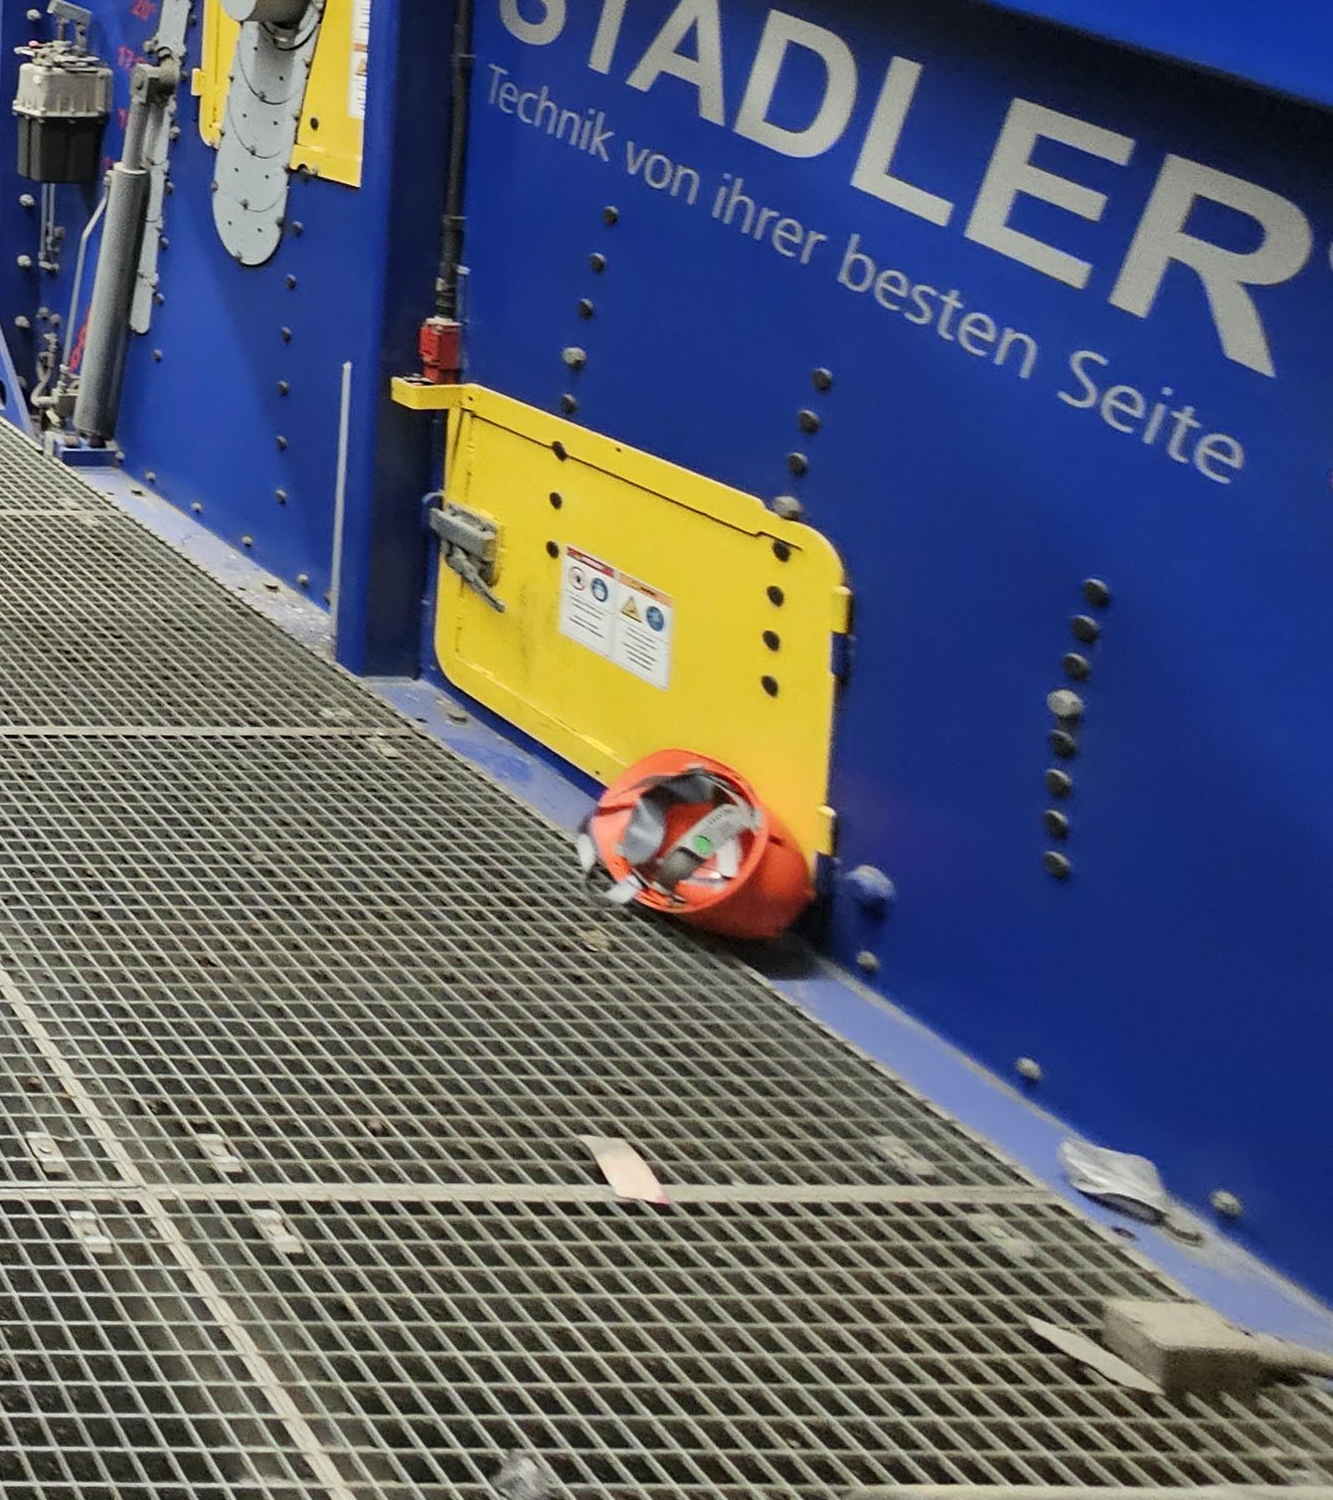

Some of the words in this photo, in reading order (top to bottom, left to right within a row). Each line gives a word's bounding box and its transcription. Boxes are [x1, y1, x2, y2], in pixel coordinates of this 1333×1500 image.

[487, 64, 615, 162] Technik
[626, 140, 700, 205] von
[711, 172, 828, 266] ihrer
[837, 233, 1038, 379] besten
[1057, 350, 1246, 485] Seite
